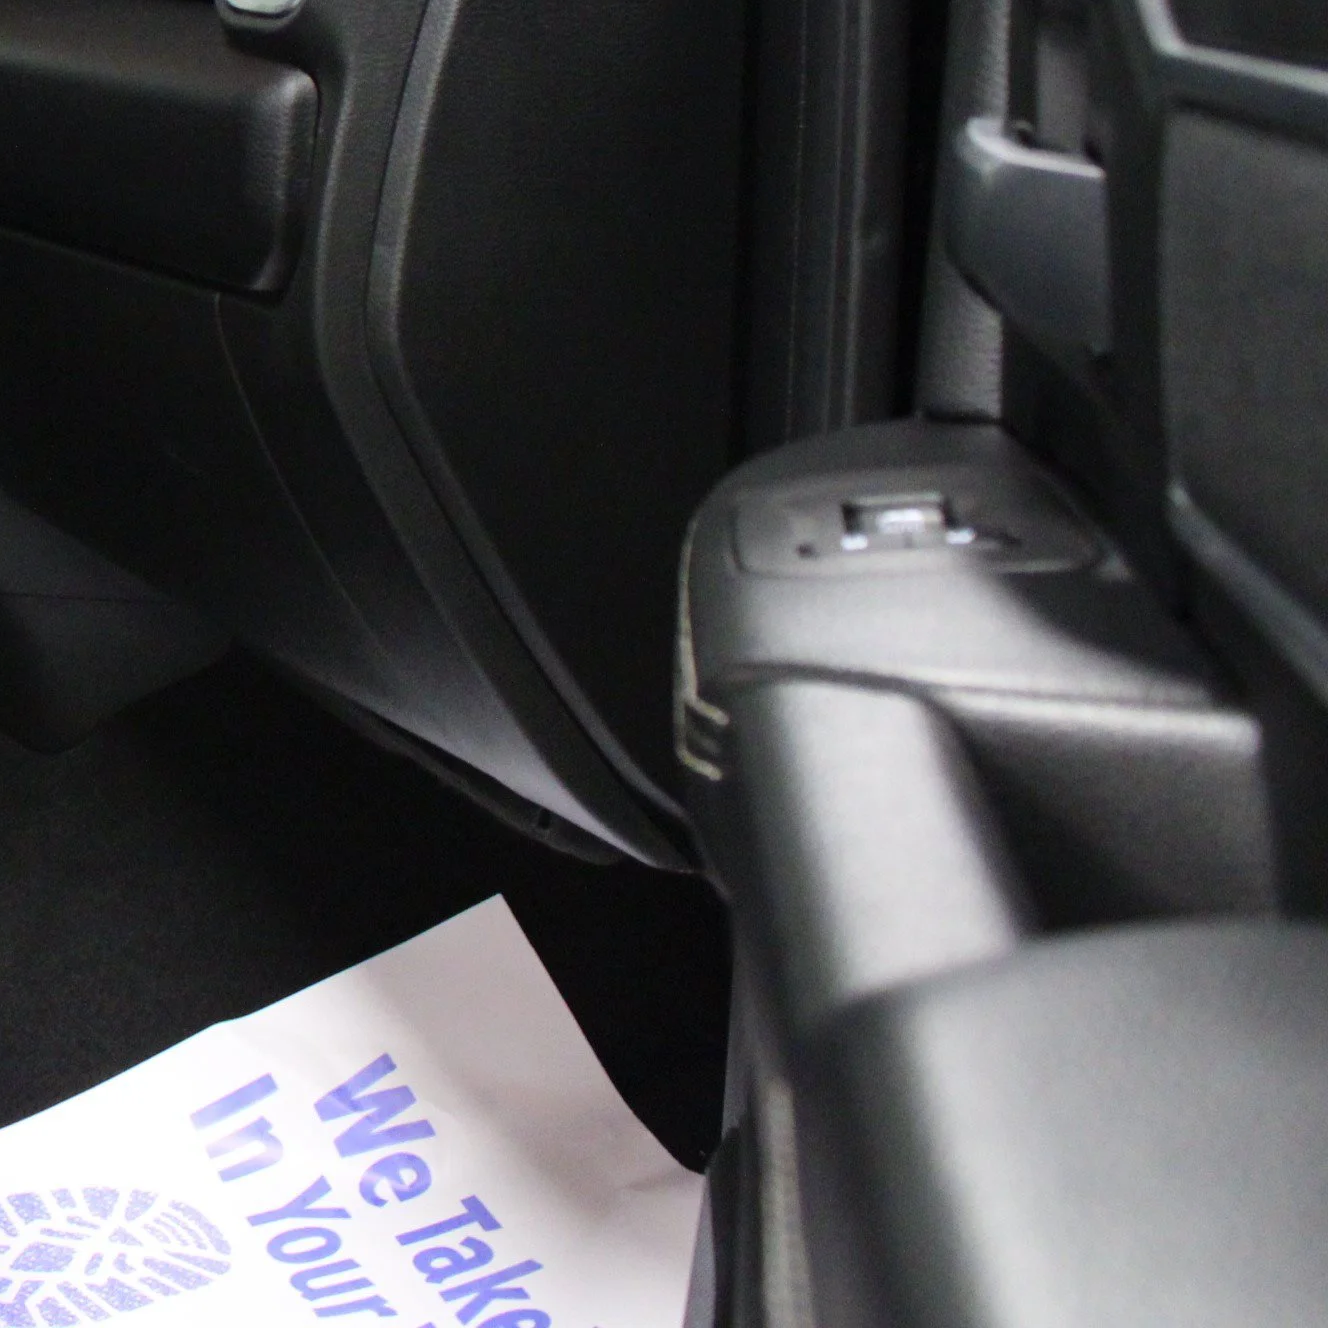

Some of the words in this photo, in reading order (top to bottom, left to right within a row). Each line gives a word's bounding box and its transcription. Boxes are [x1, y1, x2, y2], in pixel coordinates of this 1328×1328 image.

[189, 1072, 284, 1183] In
[246, 1174, 398, 1318] Your
[314, 1052, 437, 1208] We
